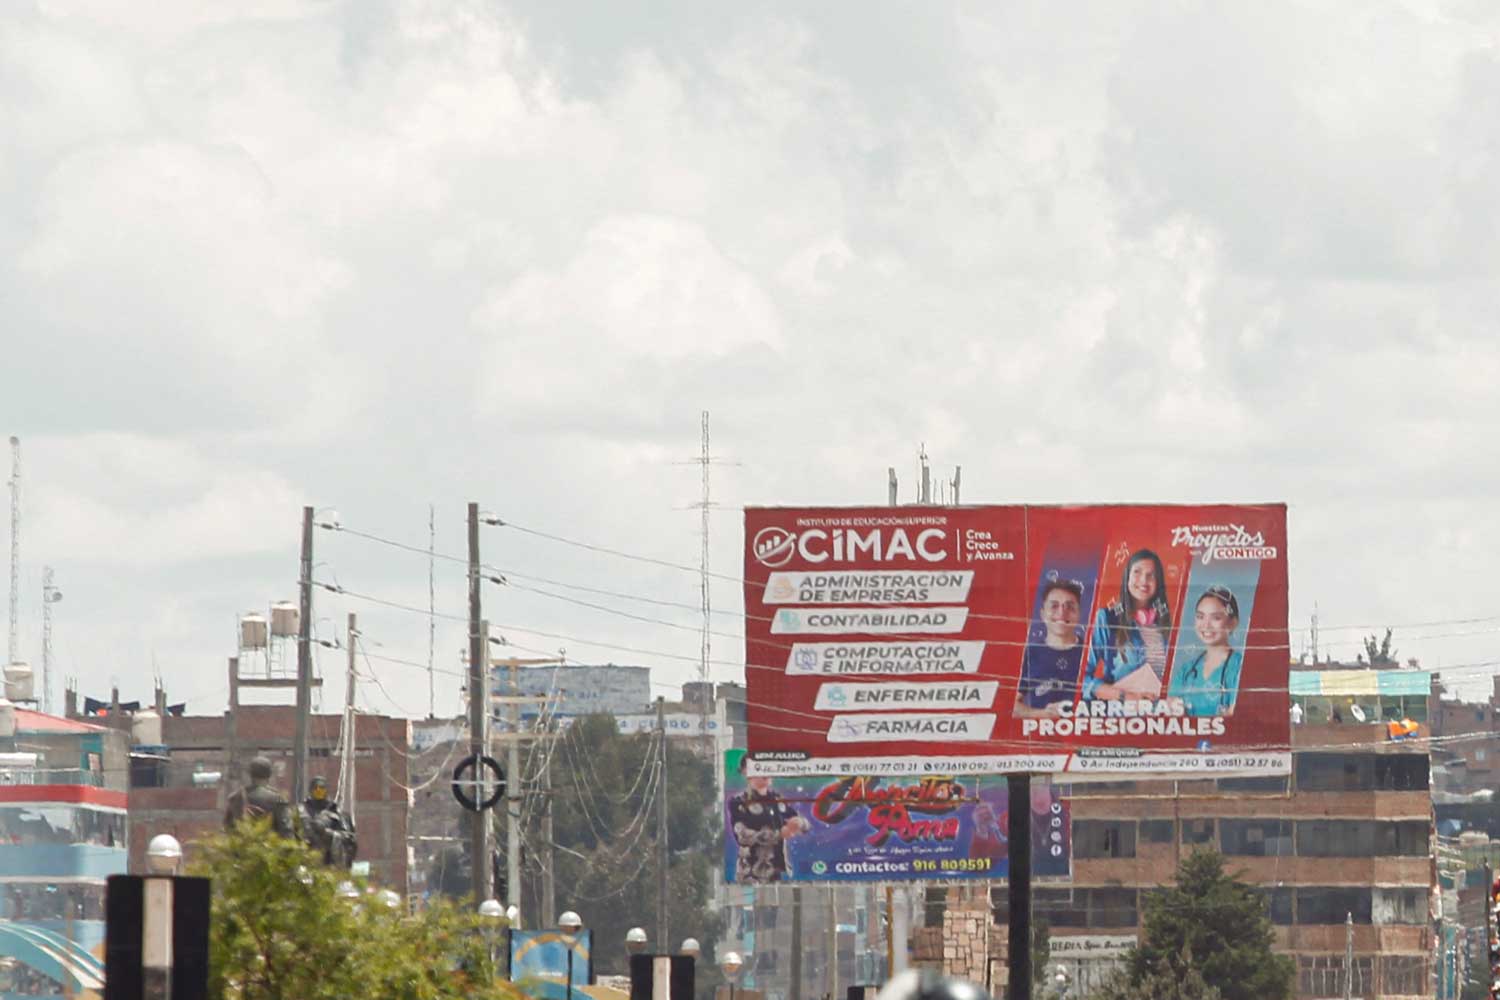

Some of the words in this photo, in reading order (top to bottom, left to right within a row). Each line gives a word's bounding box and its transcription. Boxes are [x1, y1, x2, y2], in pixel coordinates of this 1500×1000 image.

[966, 530, 992, 540] Crea
[966, 541, 999, 550] Crece
[1171, 523, 1265, 565] Proyectos
[966, 552, 973, 561] y
[974, 551, 1014, 561] Avanza
[1217, 548, 1274, 558] CONTIGO
[800, 571, 963, 588] ADMINISTRACIÓN
[800, 589, 826, 602] DE
[830, 588, 929, 602] EMPRESAS
[807, 613, 947, 627] CONTABILIDAD
[823, 643, 960, 660] COMPUTACIÓN
[822, 660, 833, 673] E
[854, 685, 981, 703] ENFERMERÍA
[1058, 700, 1185, 718] CARRERAS
[866, 720, 969, 734] FARMACIA
[1022, 717, 1226, 737] PROFESIONALES
[835, 859, 909, 874] contactos:
[912, 859, 937, 871] 916
[940, 857, 992, 871] 809591
